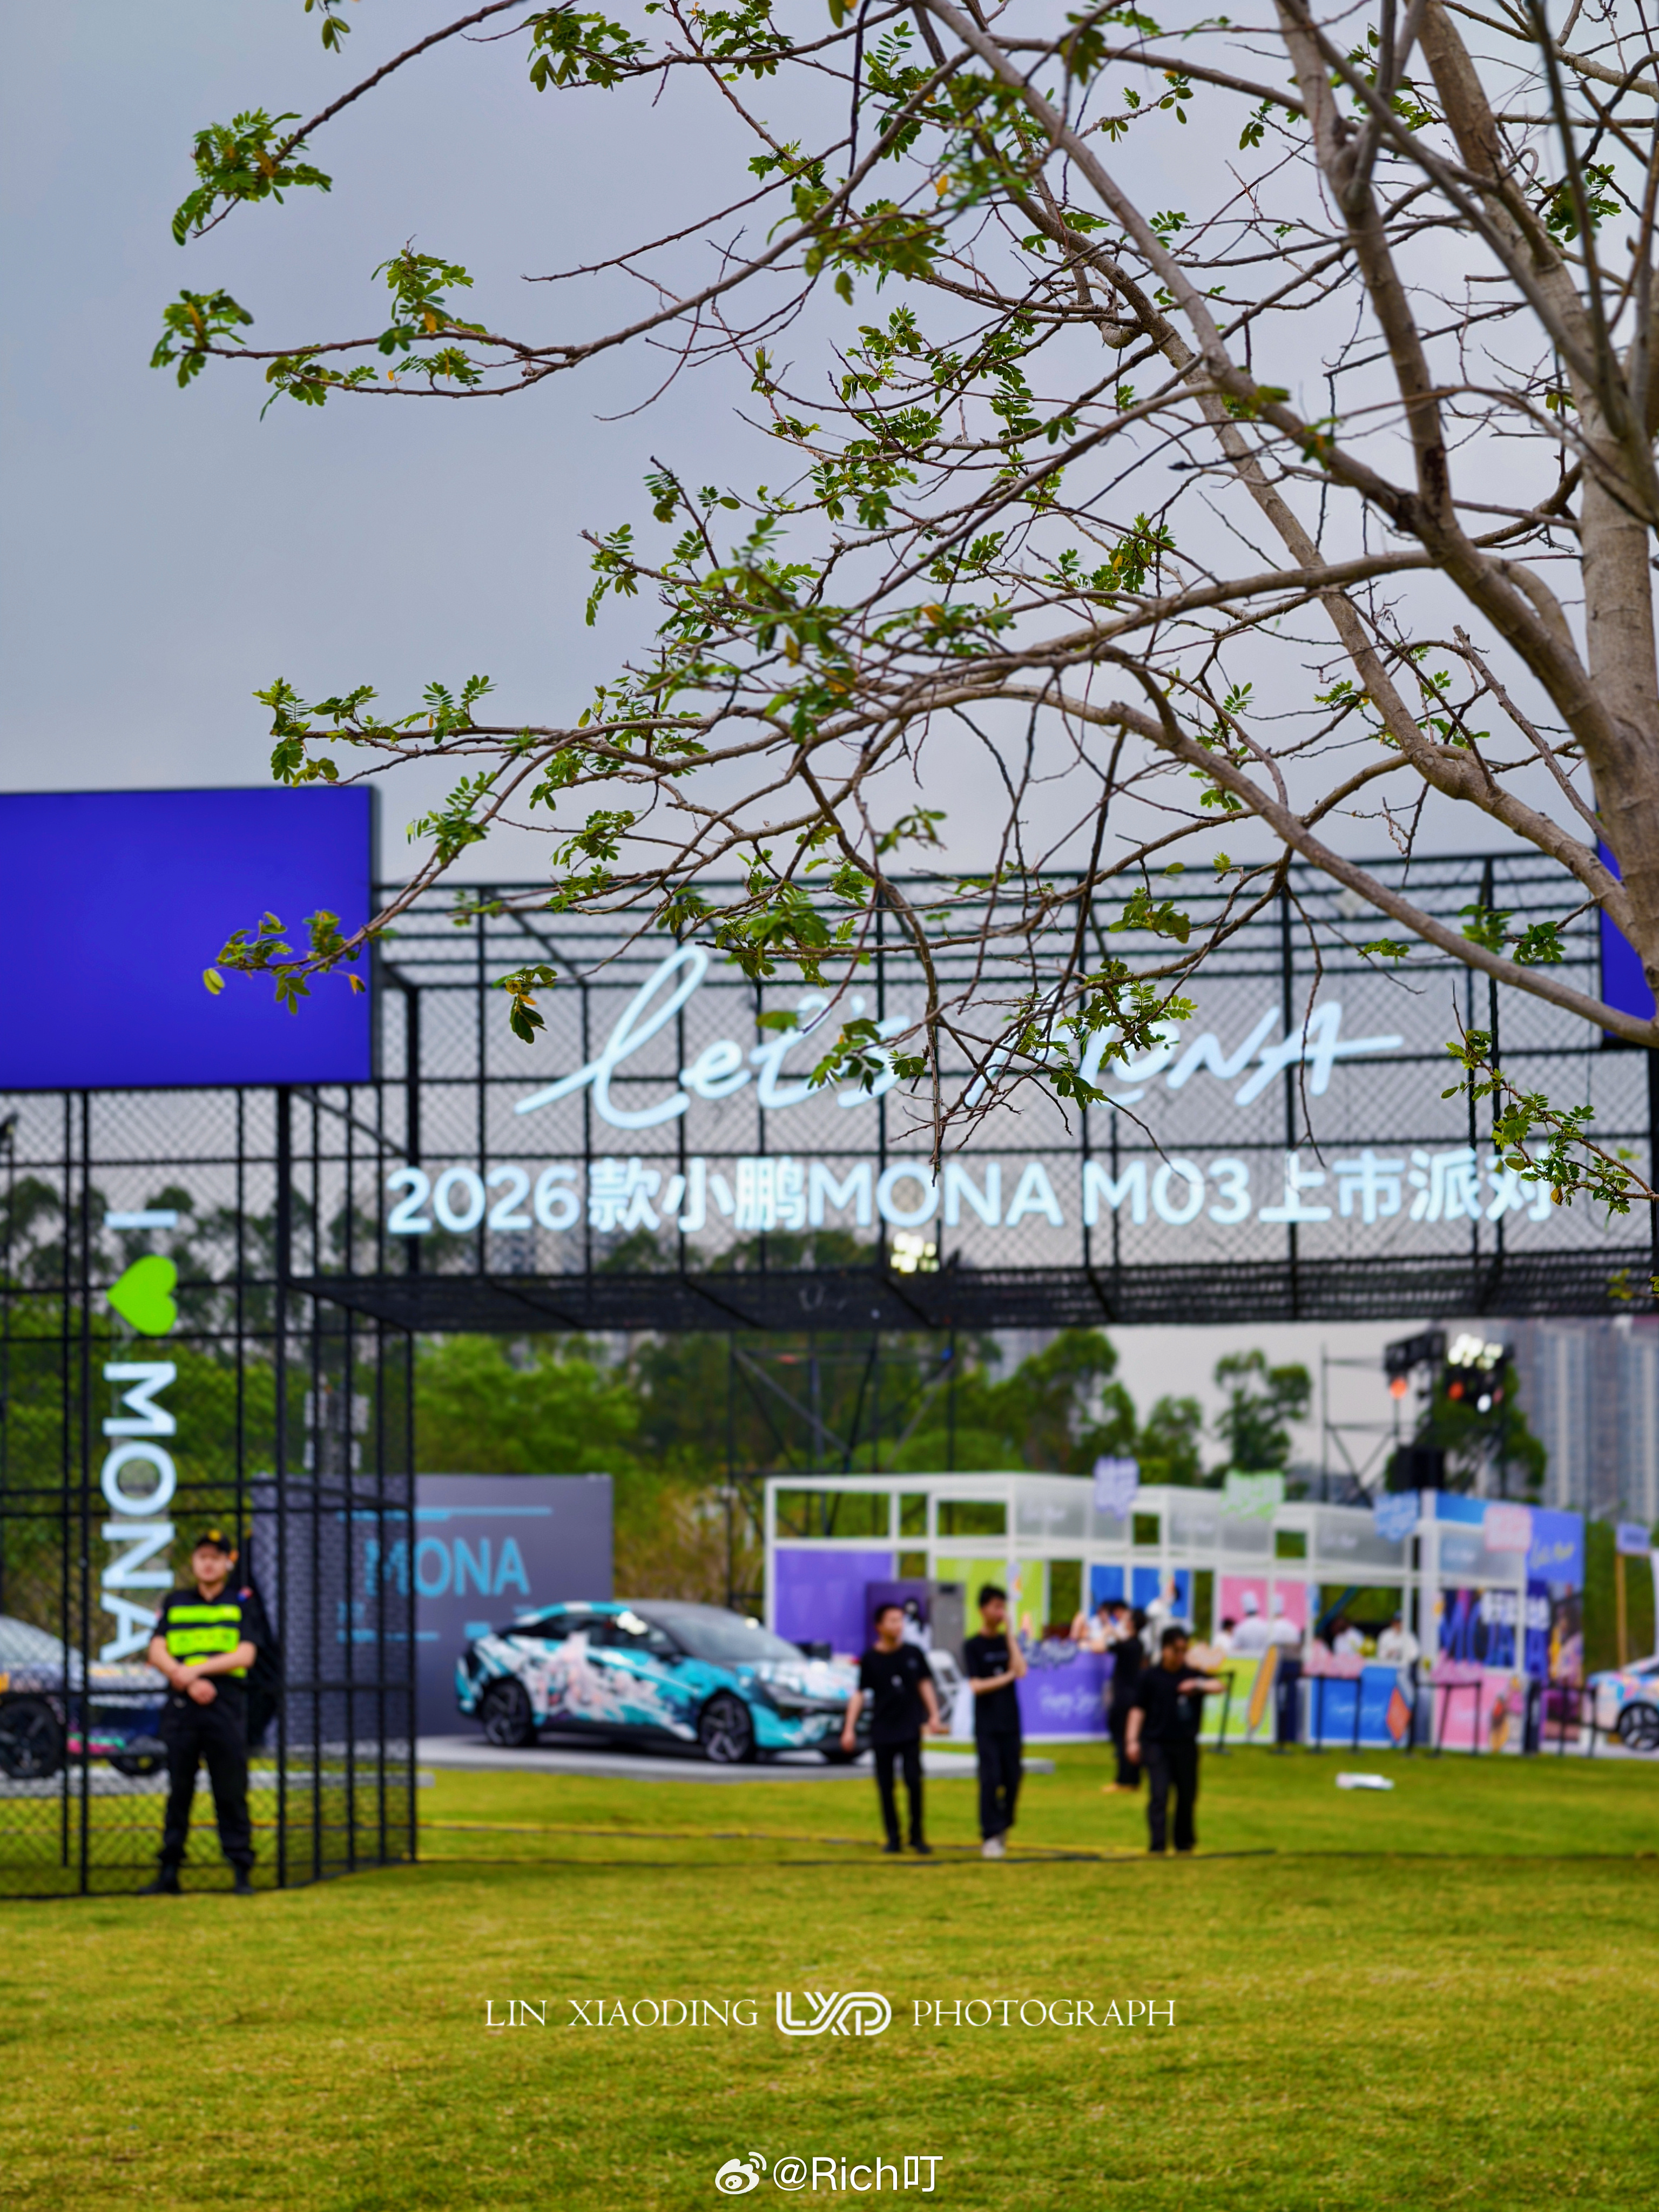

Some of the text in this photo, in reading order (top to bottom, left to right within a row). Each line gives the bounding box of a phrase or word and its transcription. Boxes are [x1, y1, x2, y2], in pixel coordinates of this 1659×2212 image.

[387, 1156, 1065, 1233] 2026款小鹏MONA
[101, 1209, 178, 1662] I MONA
[364, 1537, 530, 1597] MONA
